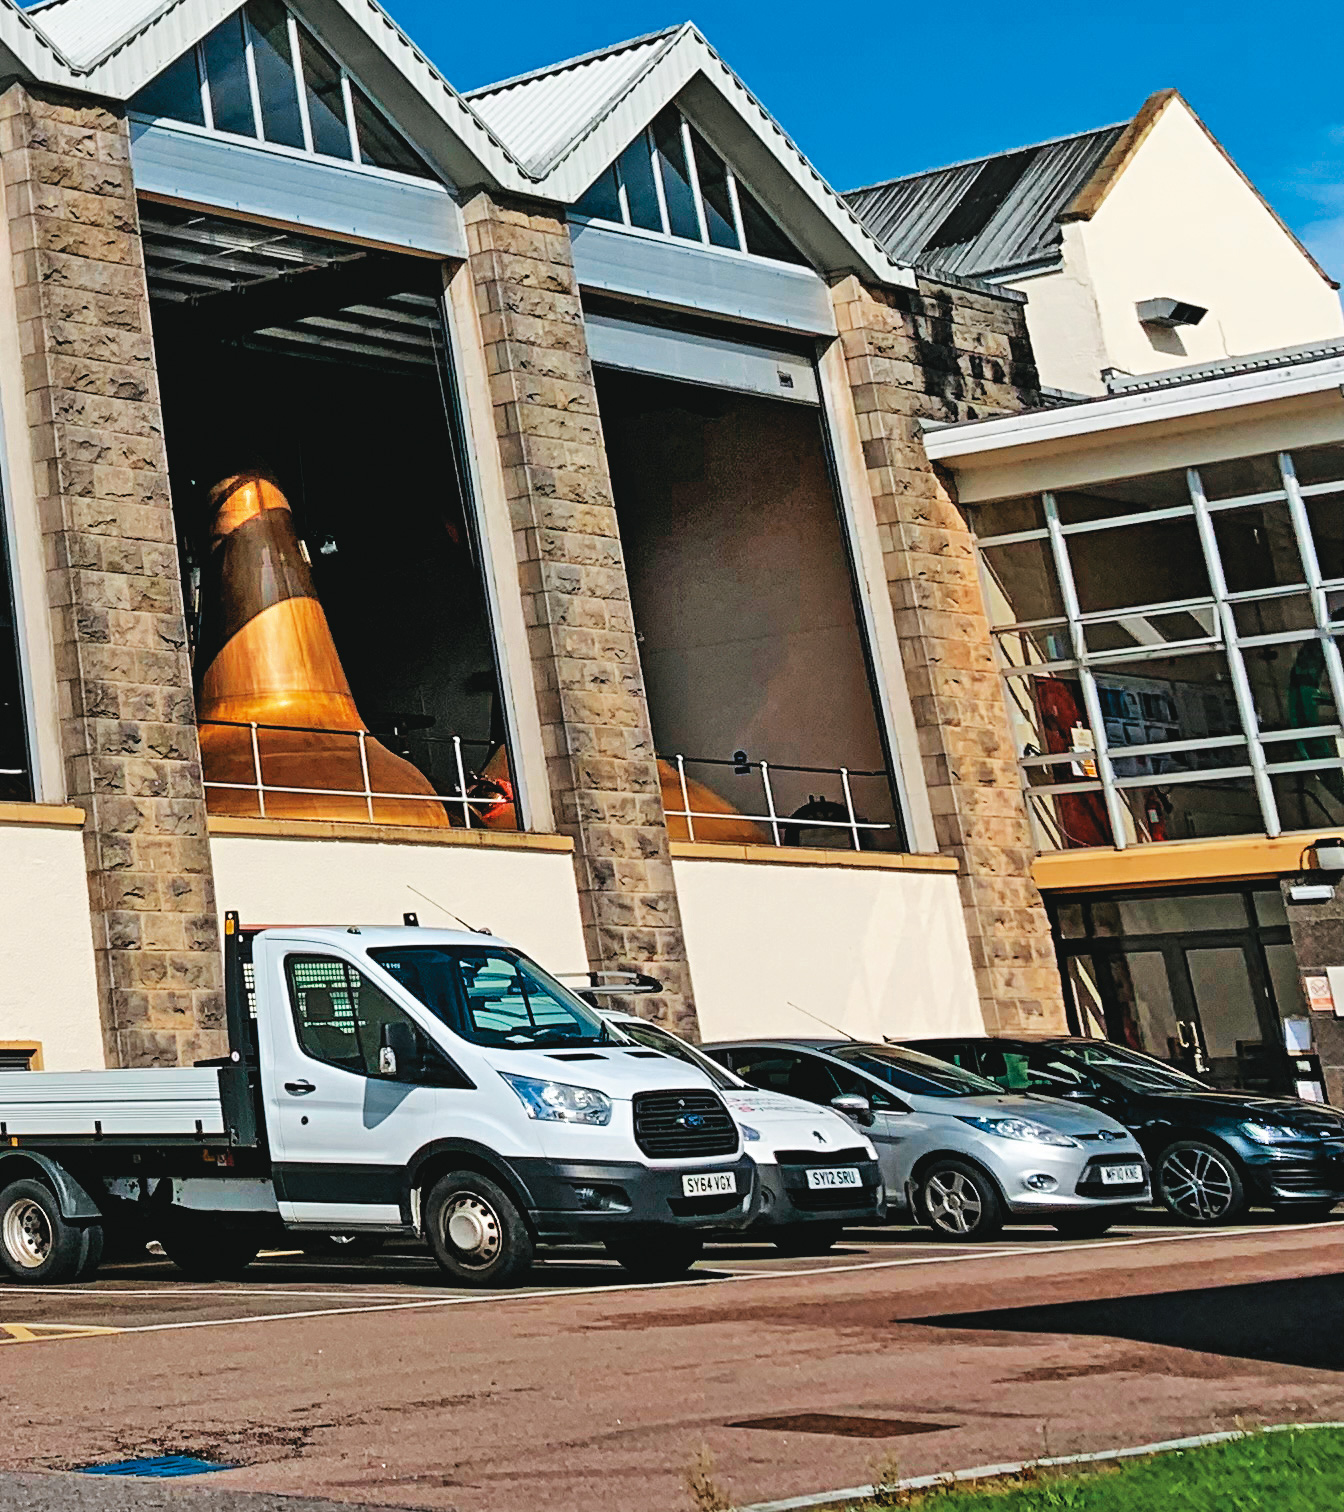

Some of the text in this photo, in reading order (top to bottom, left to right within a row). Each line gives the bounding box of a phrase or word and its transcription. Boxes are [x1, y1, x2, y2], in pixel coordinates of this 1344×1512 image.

[687, 1175, 732, 1193] SY64 VGX
[813, 1170, 856, 1185] SY12 SRU
